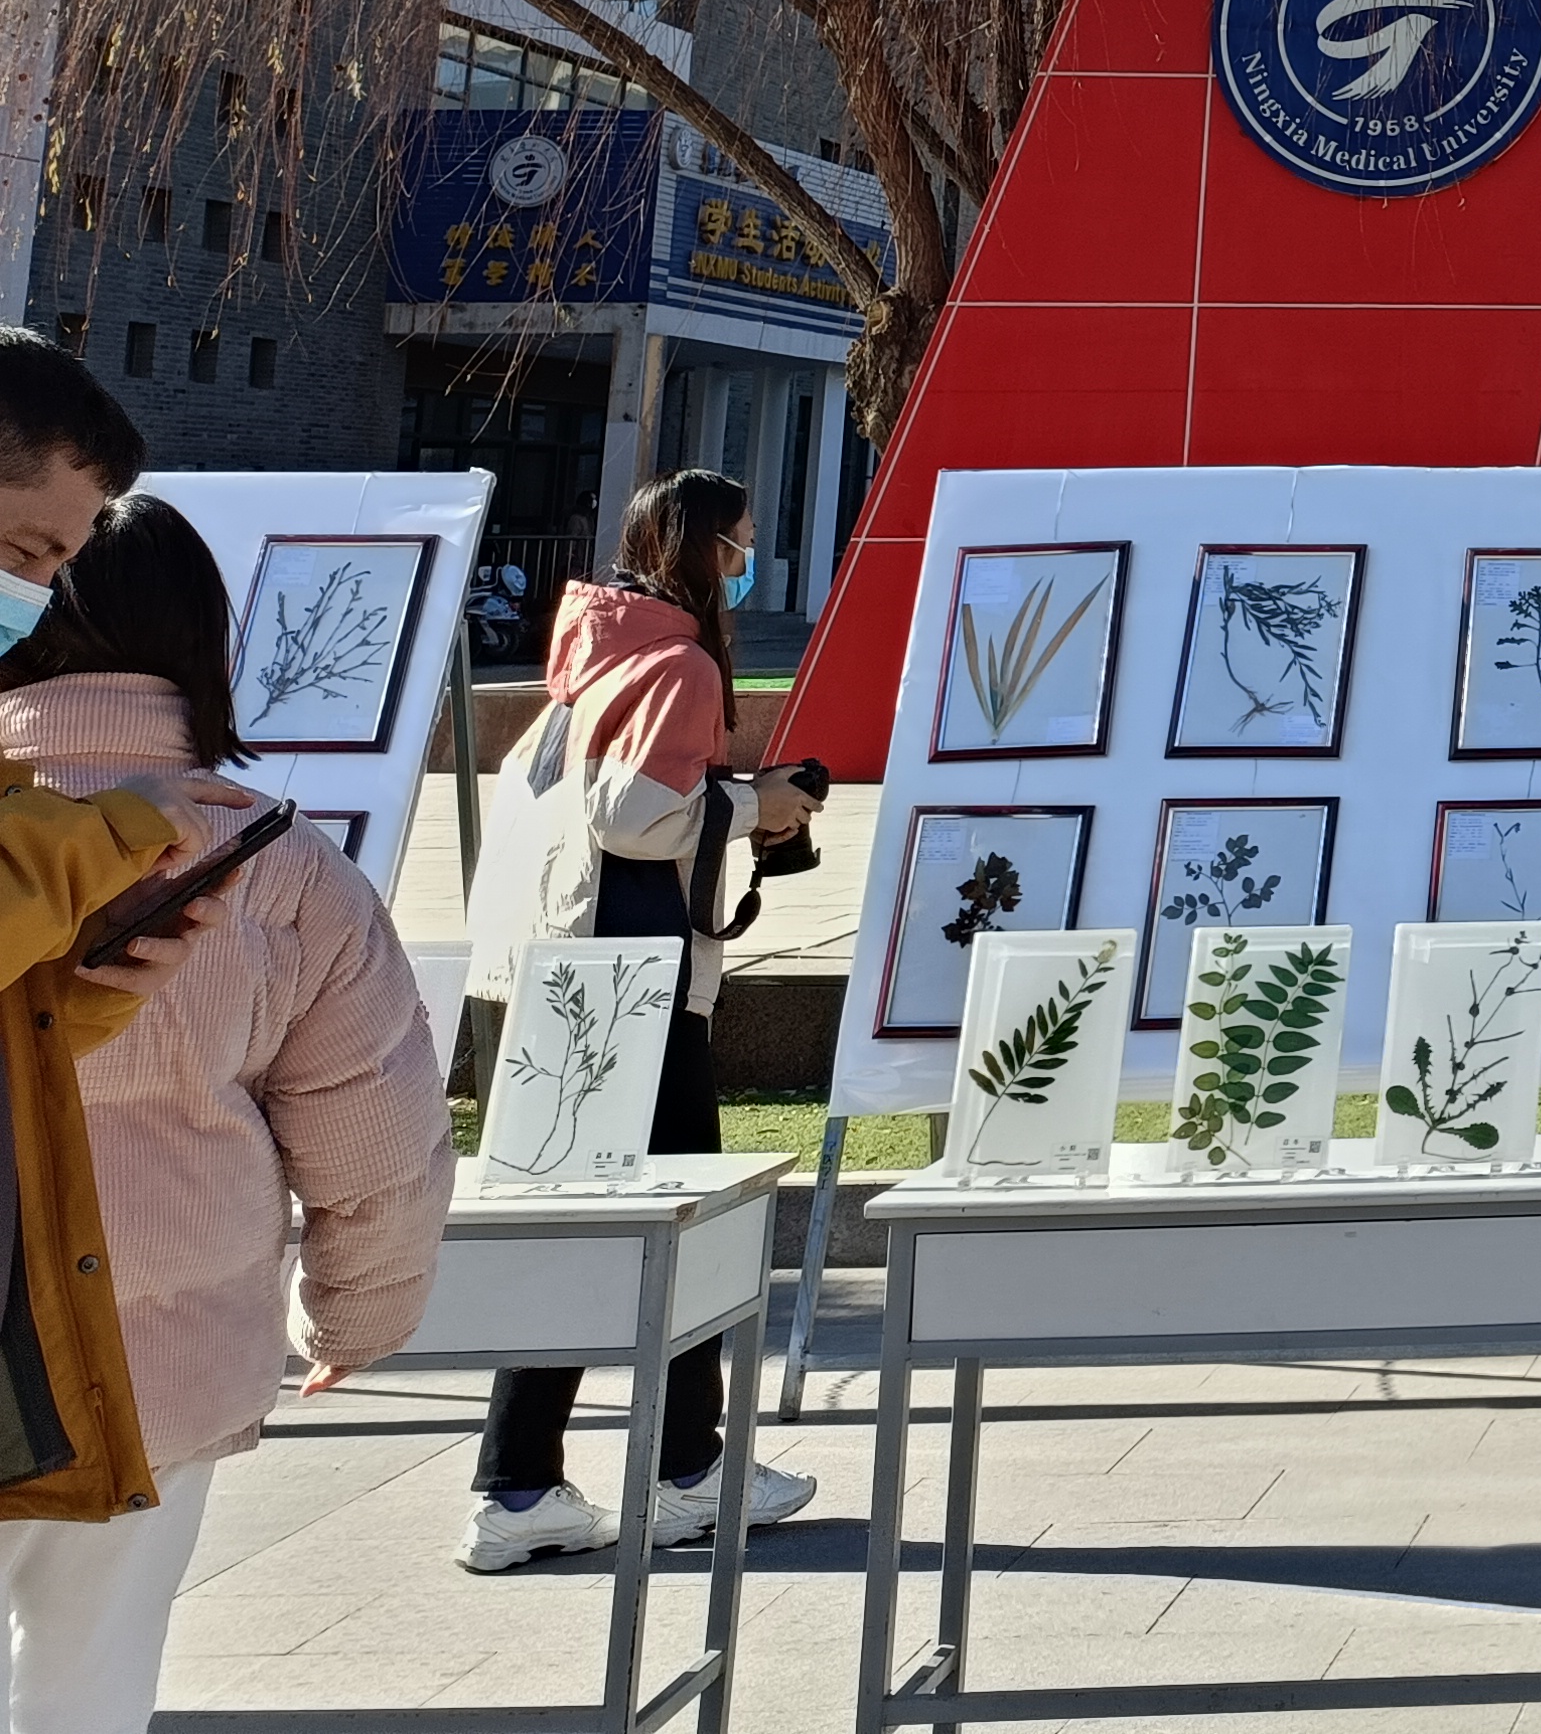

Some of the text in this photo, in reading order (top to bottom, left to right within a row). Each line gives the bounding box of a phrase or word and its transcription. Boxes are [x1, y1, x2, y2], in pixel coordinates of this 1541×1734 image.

[1241, 47, 1530, 172] Ningxia Medical University
[1354, 114, 1420, 136] 1958
[742, 262, 799, 294] Students
[802, 274, 847, 307] Activity
